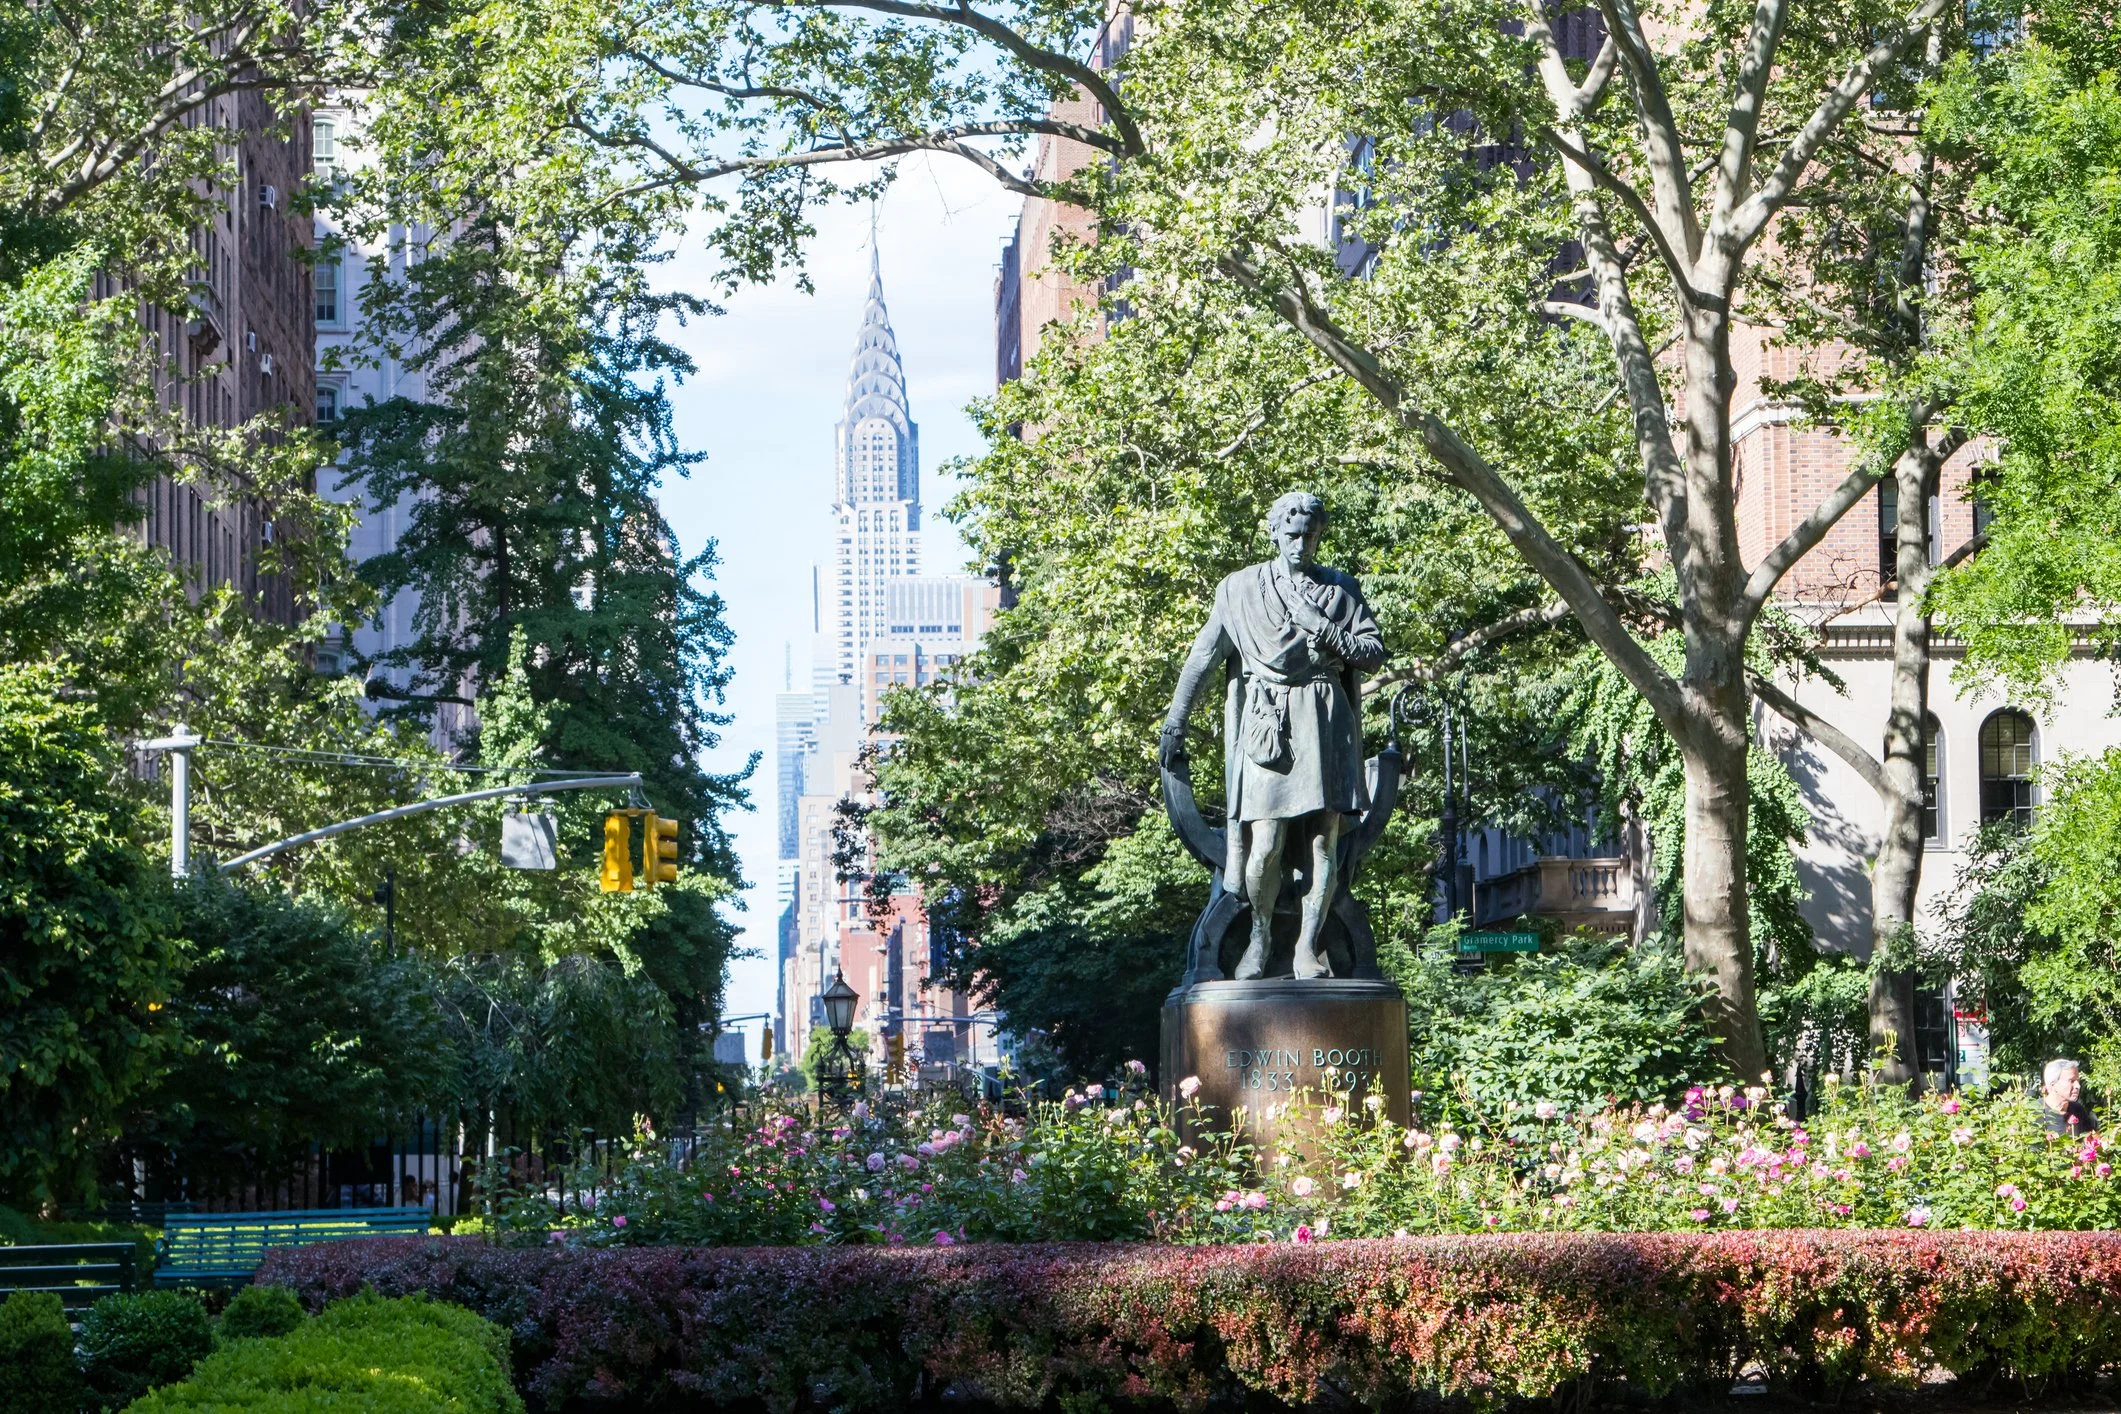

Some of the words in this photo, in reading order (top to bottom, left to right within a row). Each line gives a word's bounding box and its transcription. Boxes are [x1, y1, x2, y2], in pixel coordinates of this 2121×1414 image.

[1463, 935, 1509, 947] Gramercy
[1512, 935, 1533, 944] Park
[1227, 1049, 1300, 1068] EDWIN
[1313, 1048, 1384, 1067] BOOTH
[1241, 1069, 1294, 1091] 1833
